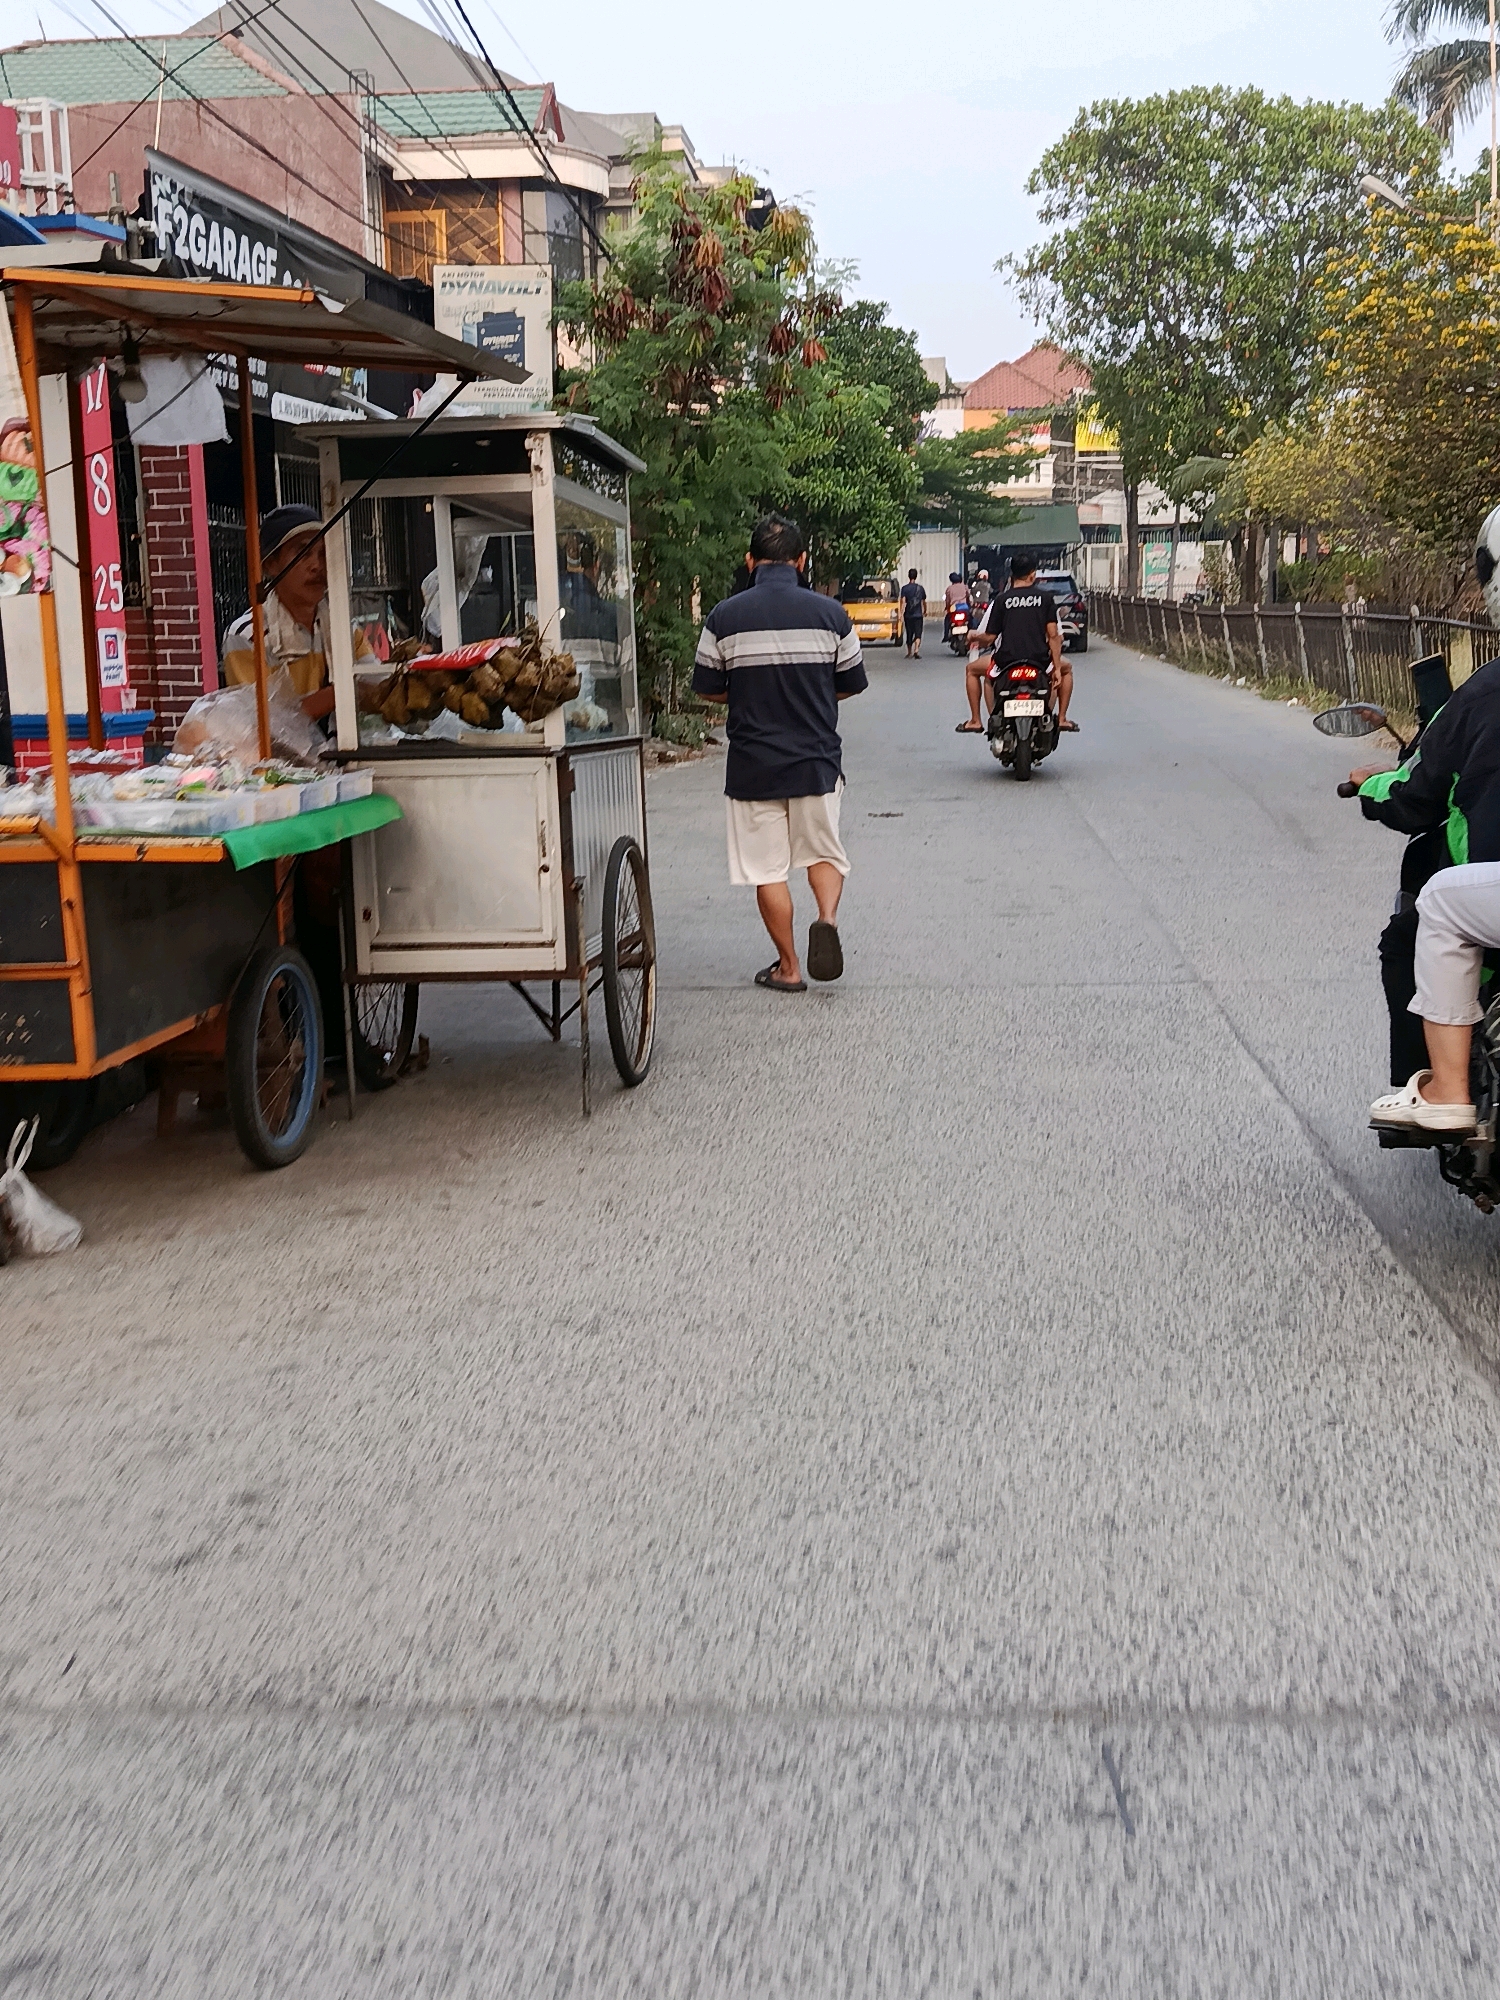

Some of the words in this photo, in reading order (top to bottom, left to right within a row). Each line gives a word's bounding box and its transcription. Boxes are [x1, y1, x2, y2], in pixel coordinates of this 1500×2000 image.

[439, 280, 544, 295] DYNAVOLT
[90, 453, 112, 516] 8
[94, 563, 124, 613] 25
[1005, 595, 1042, 610] COACH
